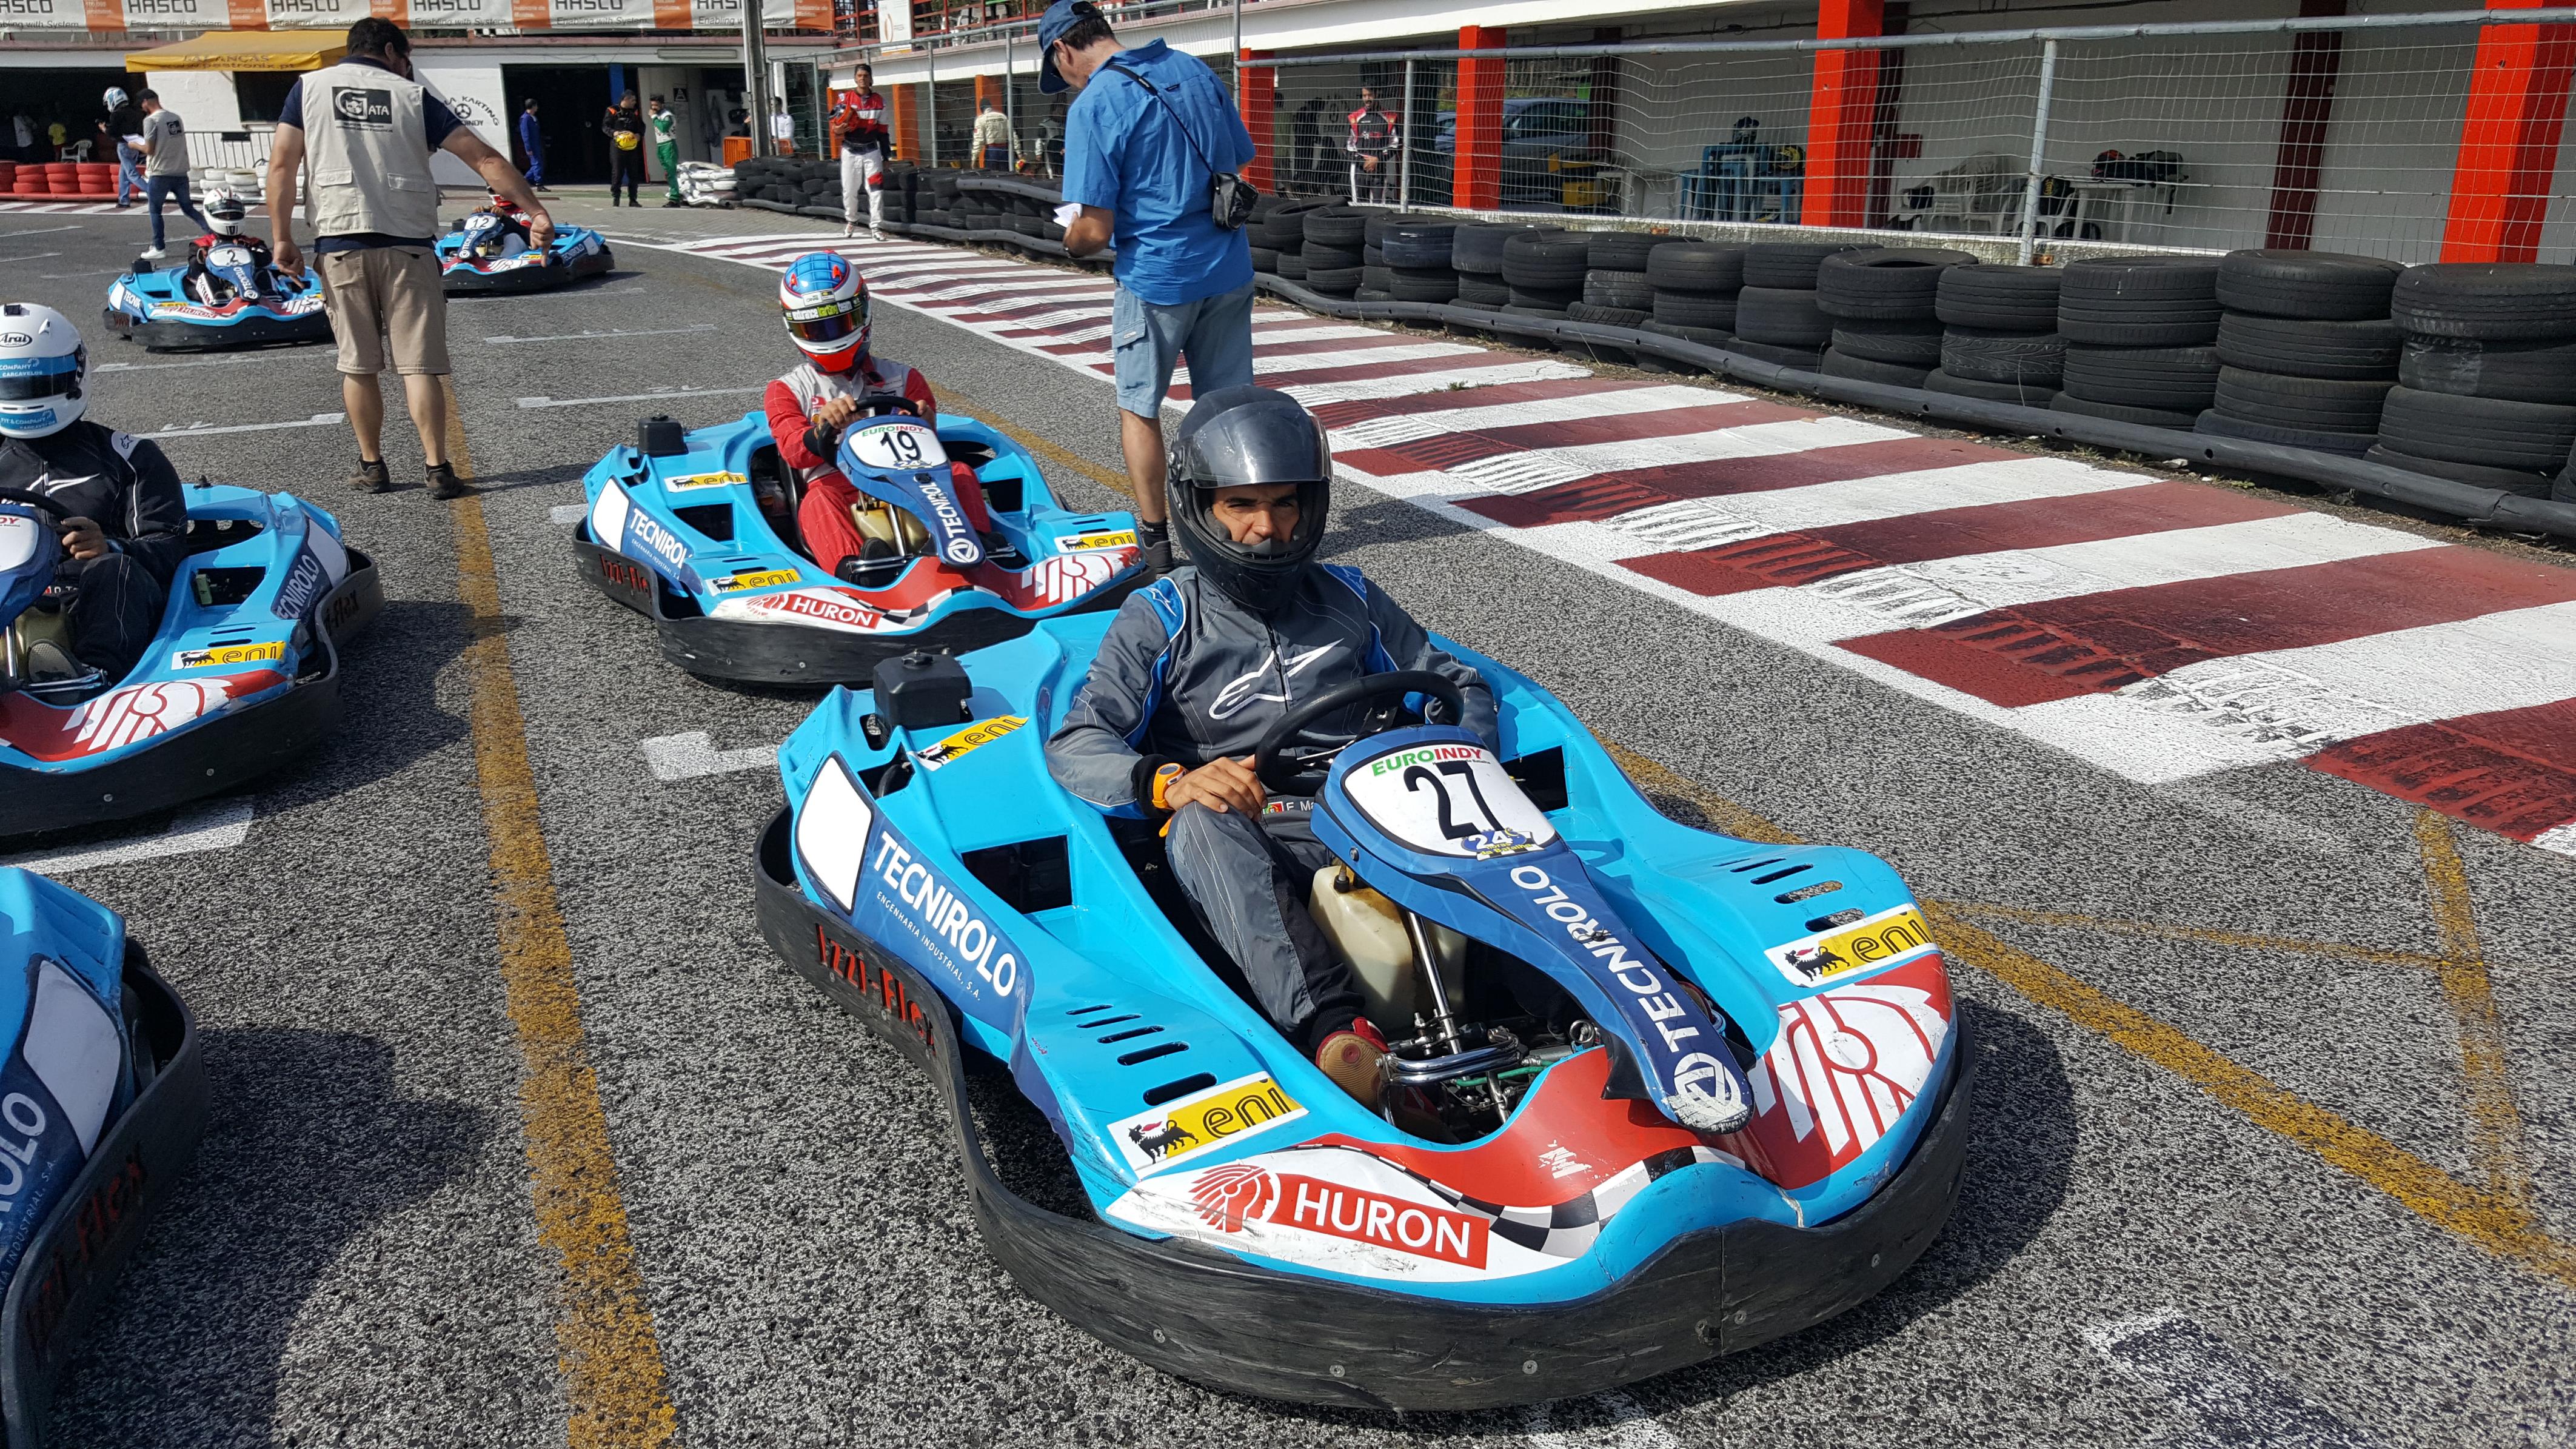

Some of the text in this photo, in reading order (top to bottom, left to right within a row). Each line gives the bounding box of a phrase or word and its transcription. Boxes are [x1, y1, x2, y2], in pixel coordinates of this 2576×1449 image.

[0, 0, 53, 13] ASCO
[698, 16, 734, 25] Enabling
[335, 89, 389, 119] GATA
[462, 96, 499, 126] KARTING
[473, 218, 489, 228] 12
[227, 249, 238, 262] 2
[1, 334, 27, 343] Arai
[861, 426, 924, 437] EUROINDY
[880, 430, 923, 462] 19
[704, 473, 747, 485] eni
[914, 475, 966, 538] TECNIROL
[1094, 532, 1135, 547] eni
[276, 554, 319, 619] ECNIROLO
[749, 569, 797, 588] eni
[792, 597, 874, 627] HURON
[222, 641, 278, 664] eni
[965, 714, 1026, 746] eni
[1371, 747, 1481, 777] EUROINDY
[1403, 760, 1505, 840] 27
[1468, 831, 1513, 849] 24
[874, 831, 1016, 997] TECNIROLO
[877, 891, 980, 1001] ENGENHARIA INDUSTRIAL, S.A.
[1851, 910, 1933, 963] eni
[1510, 865, 1701, 1052] TECNIROLO
[1203, 1078, 1293, 1139] eni
[1294, 1183, 1471, 1259] HURON
